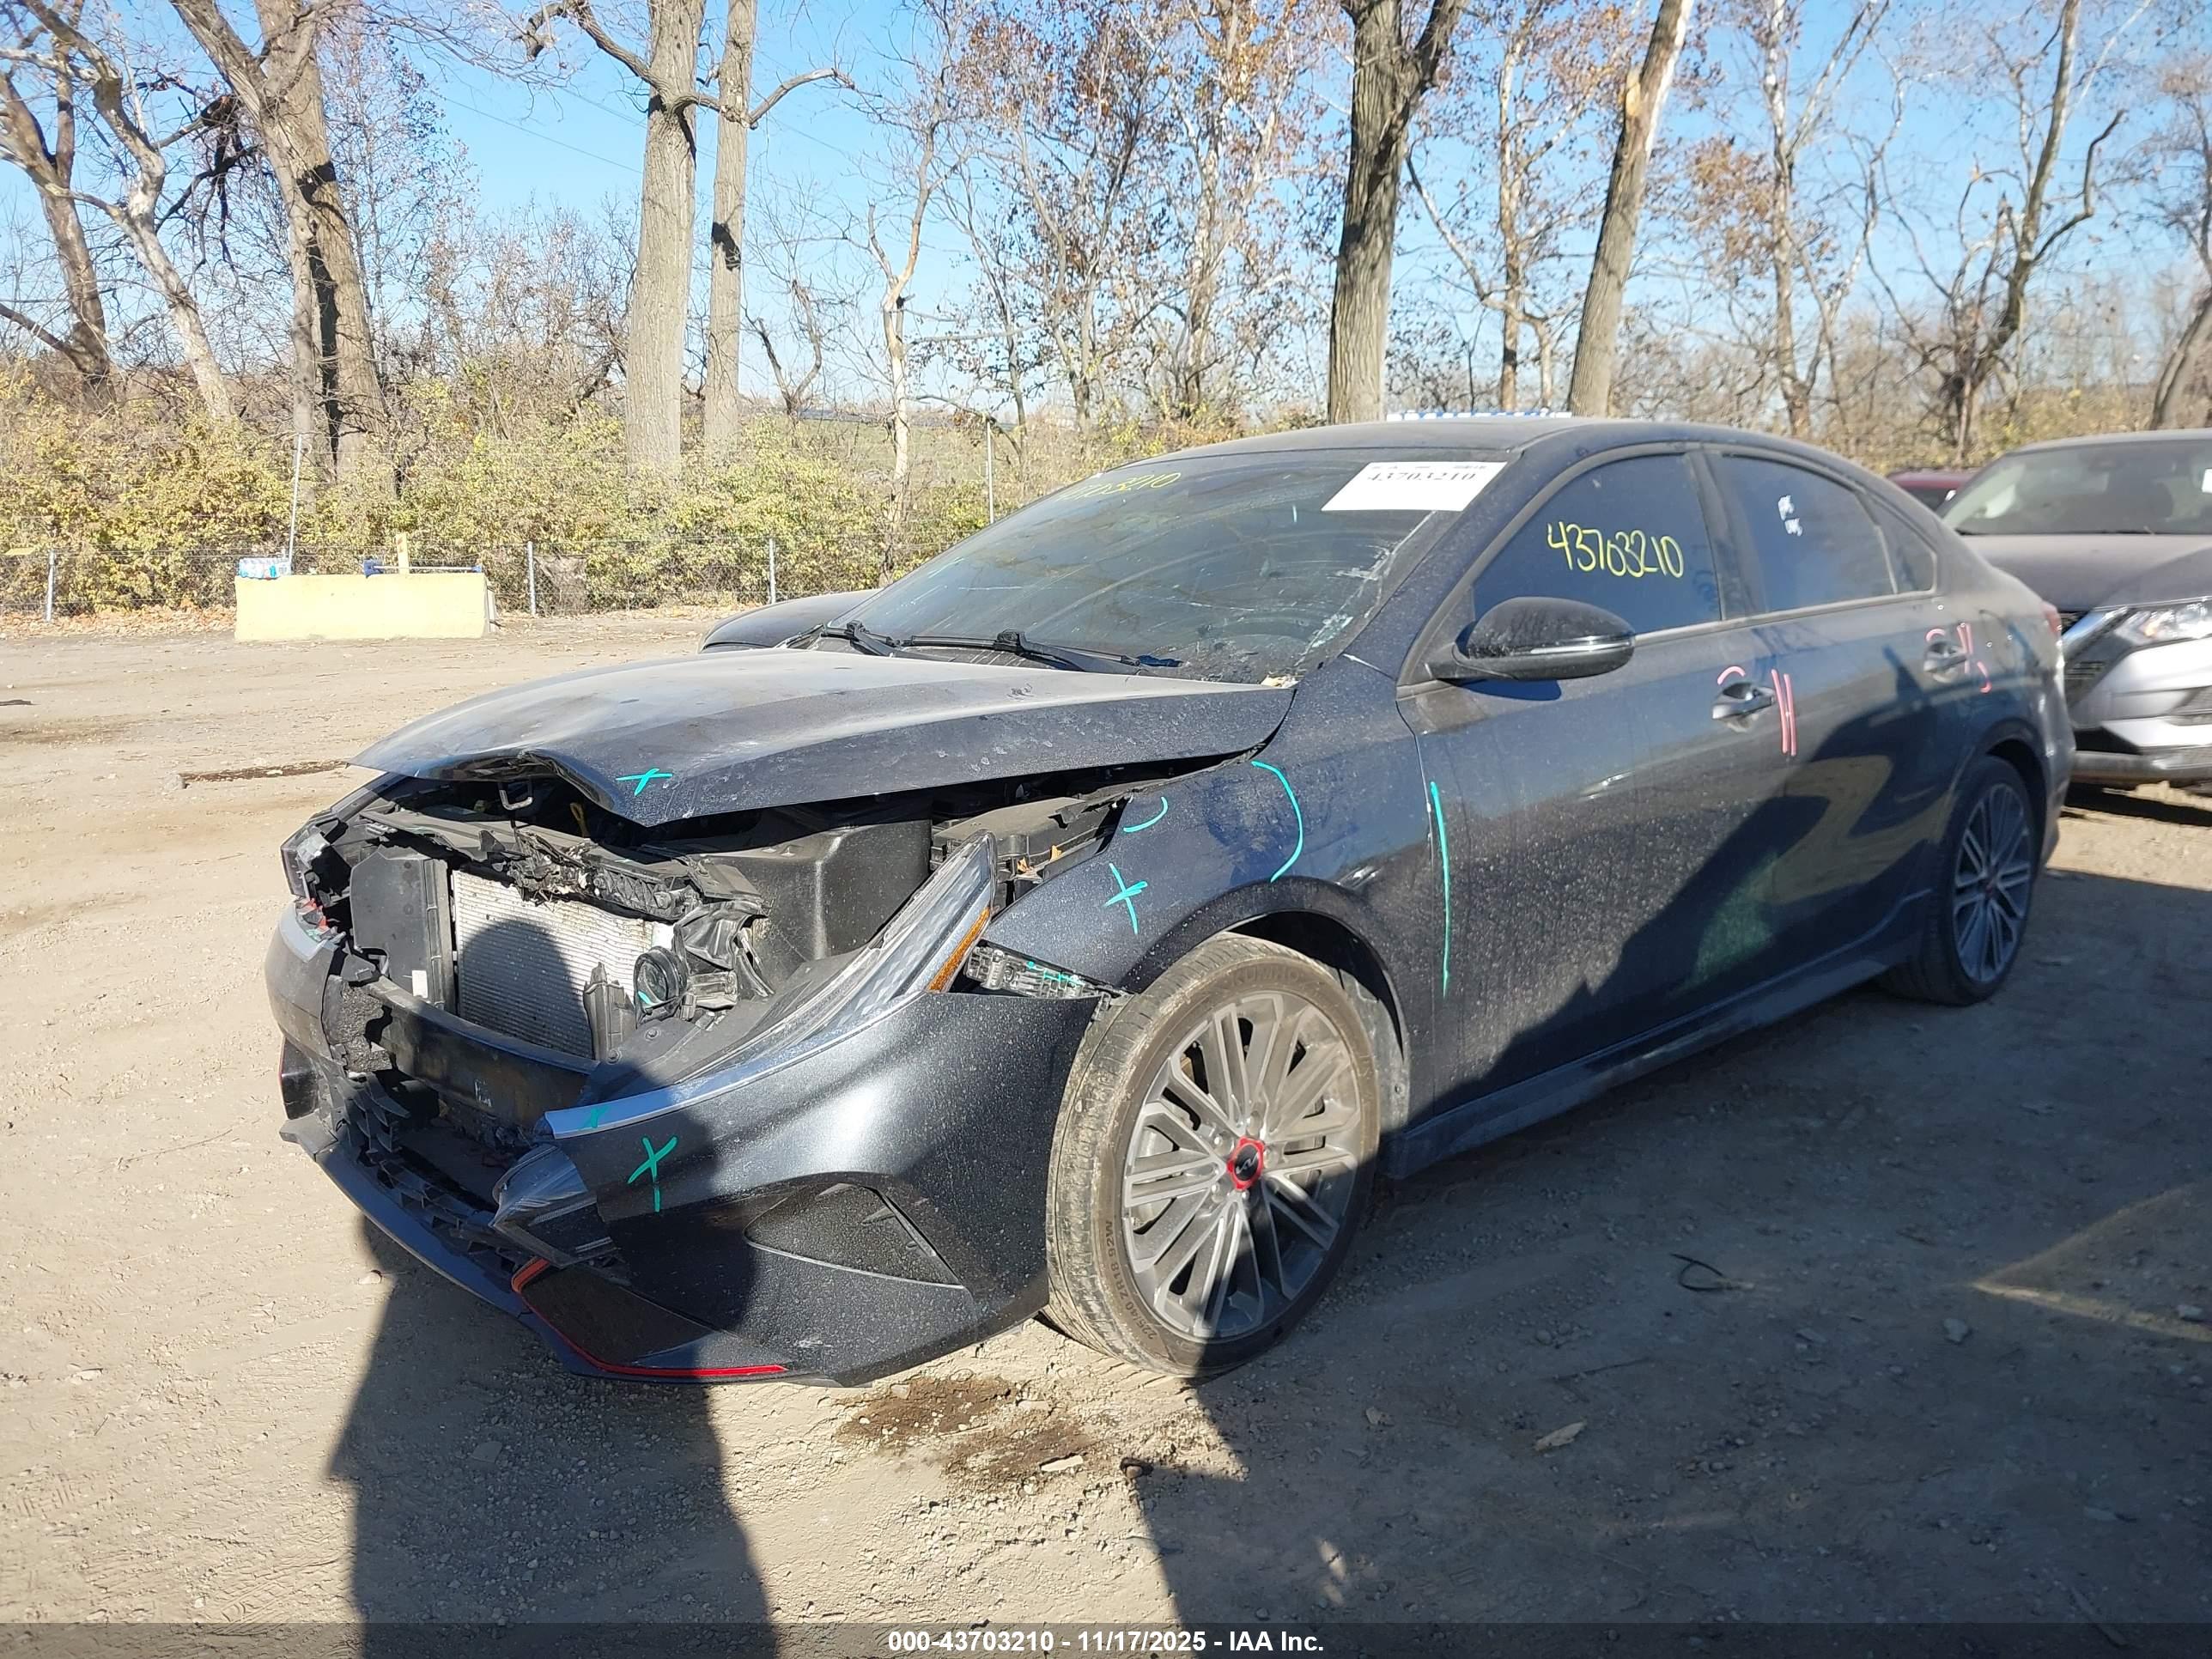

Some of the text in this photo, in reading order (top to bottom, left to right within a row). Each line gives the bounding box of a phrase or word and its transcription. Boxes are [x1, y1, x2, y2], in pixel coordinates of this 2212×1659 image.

[1367, 472, 1476, 481] 43703210
[1547, 520, 1684, 578] 43703210
[1105, 1221, 1158, 1340] 225/40 ZR18 92W
